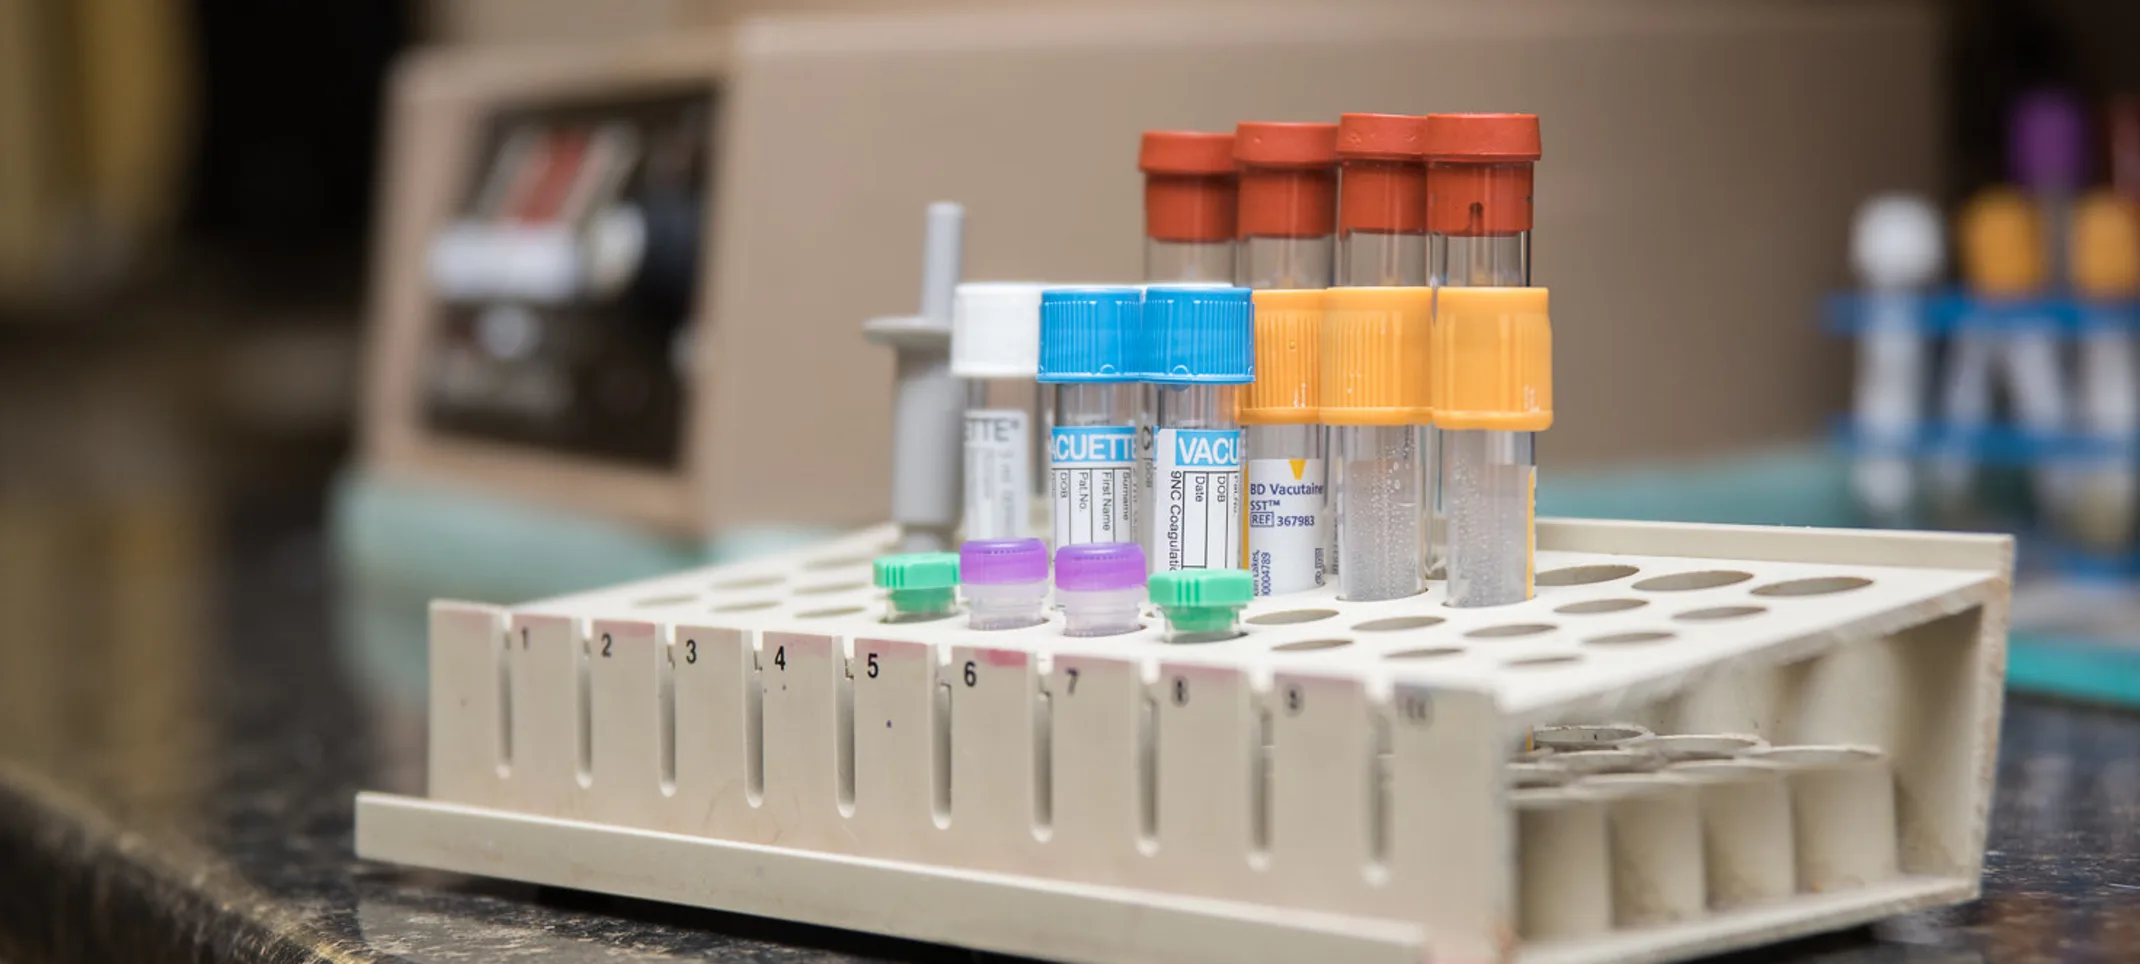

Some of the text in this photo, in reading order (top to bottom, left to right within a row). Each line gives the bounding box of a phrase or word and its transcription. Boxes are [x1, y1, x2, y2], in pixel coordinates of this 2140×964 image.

[1178, 437, 1240, 465] VACU
[1171, 470, 1182, 501] 9NC
[1195, 476, 1206, 502] Date
[1217, 476, 1226, 503] DOB
[1250, 483, 1266, 495] BD
[1101, 472, 1112, 532] First Name
[1251, 514, 1315, 527] REF 367983
[521, 627, 529, 650] 1
[601, 633, 612, 657] 2
[686, 639, 697, 664] 3
[774, 645, 786, 671] 4
[867, 653, 879, 678] 5
[963, 661, 977, 687] 6
[1064, 667, 1080, 696] 7
